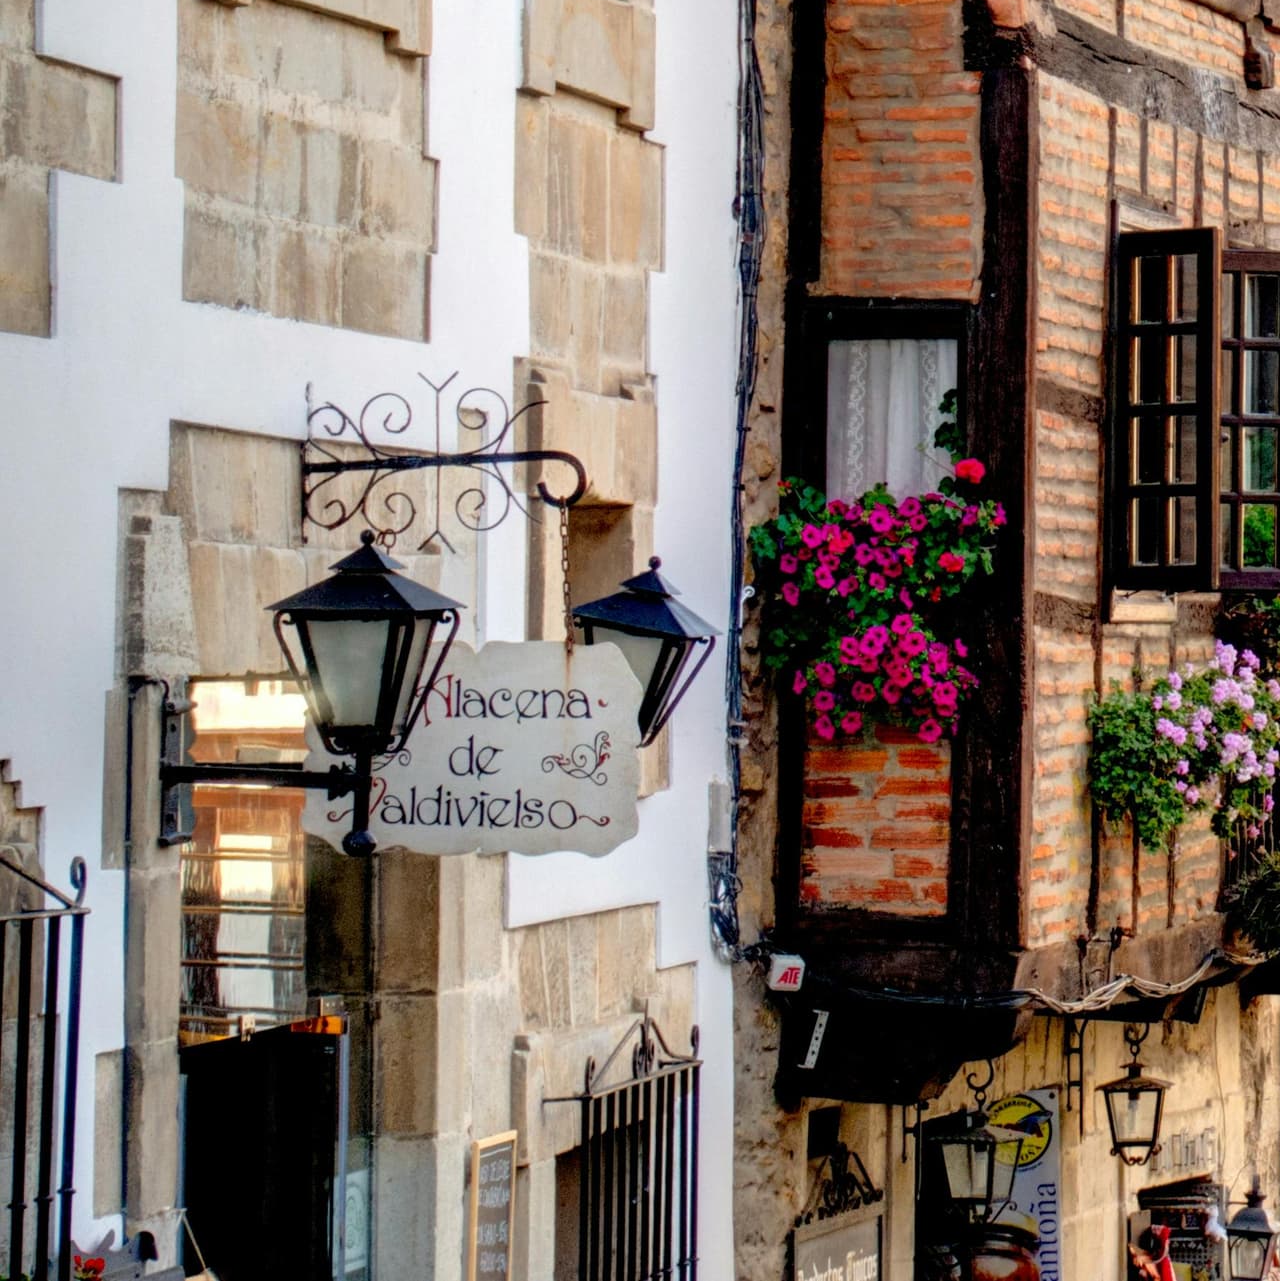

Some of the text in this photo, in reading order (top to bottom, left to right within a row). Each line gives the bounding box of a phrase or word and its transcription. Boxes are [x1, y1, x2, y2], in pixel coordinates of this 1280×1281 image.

[416, 674, 592, 726] Alacena
[449, 735, 504, 780] de
[777, 967, 801, 985] ATE
